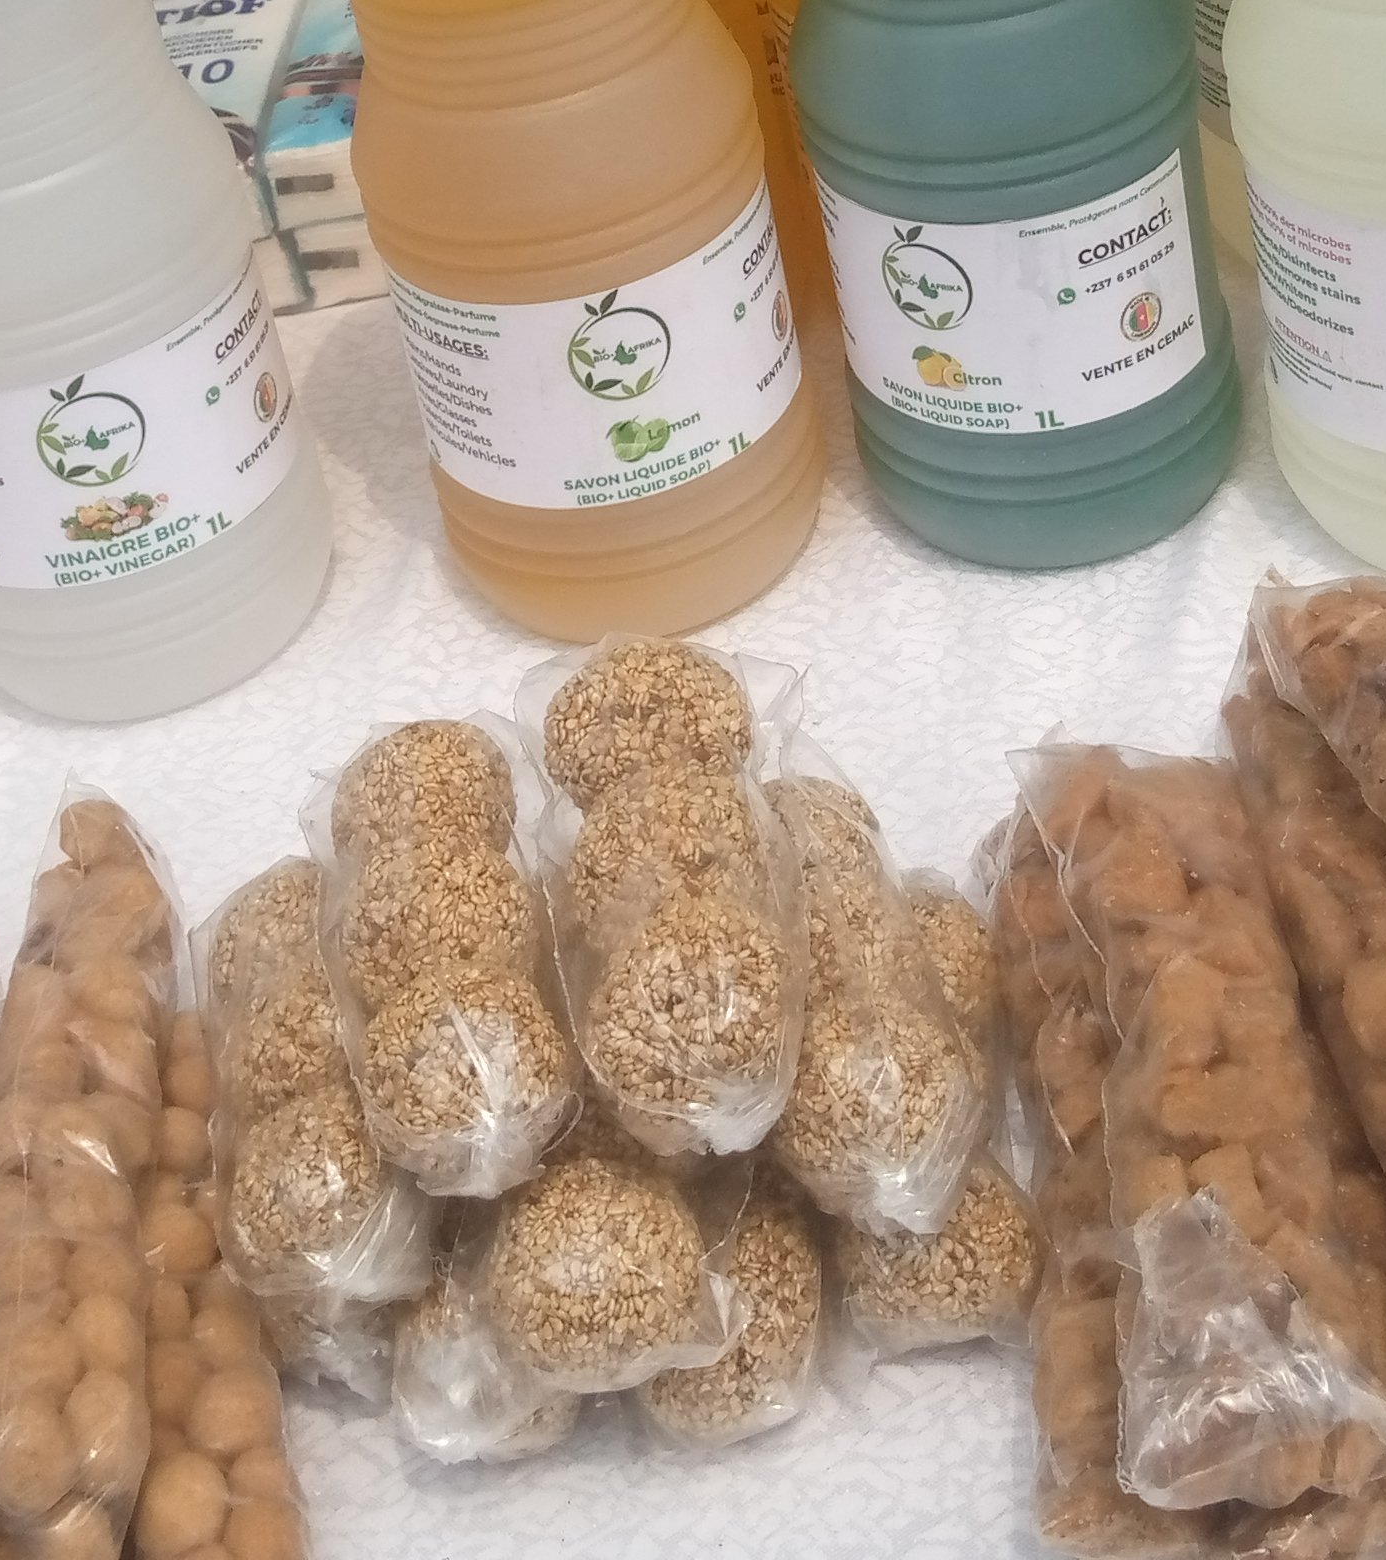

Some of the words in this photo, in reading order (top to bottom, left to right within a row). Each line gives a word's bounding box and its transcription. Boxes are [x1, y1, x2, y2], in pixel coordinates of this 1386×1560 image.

[1077, 207, 1173, 266] CONTACT:
[1297, 224, 1353, 252] microbes
[1298, 240, 1353, 266] microbes
[1085, 277, 1112, 295] +237
[1116, 271, 1125, 283] 6
[1126, 266, 1138, 280] 51
[1139, 259, 1150, 272] 61
[1320, 285, 1362, 306] stains
[627, 336, 663, 354] AFRIKA
[1080, 354, 1134, 383] VENTE
[1135, 344, 1156, 363] EN
[1157, 313, 1195, 351] CEMAC
[756, 353, 785, 393] VENTE
[952, 372, 1003, 387] Citron
[882, 376, 923, 403] SAVON
[924, 392, 984, 414] LIQUIDE
[987, 402, 1024, 415] BIO+
[1034, 409, 1065, 429] 1L
[890, 395, 919, 415] (BIO+
[919, 407, 964, 426] LIQUID
[965, 417, 1011, 430] SOAP)
[99, 420, 136, 439] AFRIKA
[234, 435, 271, 475] VENTE
[563, 472, 622, 492] SAVON
[623, 452, 688, 484] LIQUIDE
[688, 438, 722, 462] BIO+
[726, 430, 753, 456] 1L
[576, 493, 614, 507] (BIO+
[617, 480, 668, 501] LIQUID
[668, 459, 712, 485] SOAP)
[44, 532, 152, 569] VINAIGRE
[154, 512, 201, 543] BIO+
[205, 510, 234, 537] 1L
[53, 568, 103, 588] (BIO+
[104, 532, 197, 577] VINEGAR)
